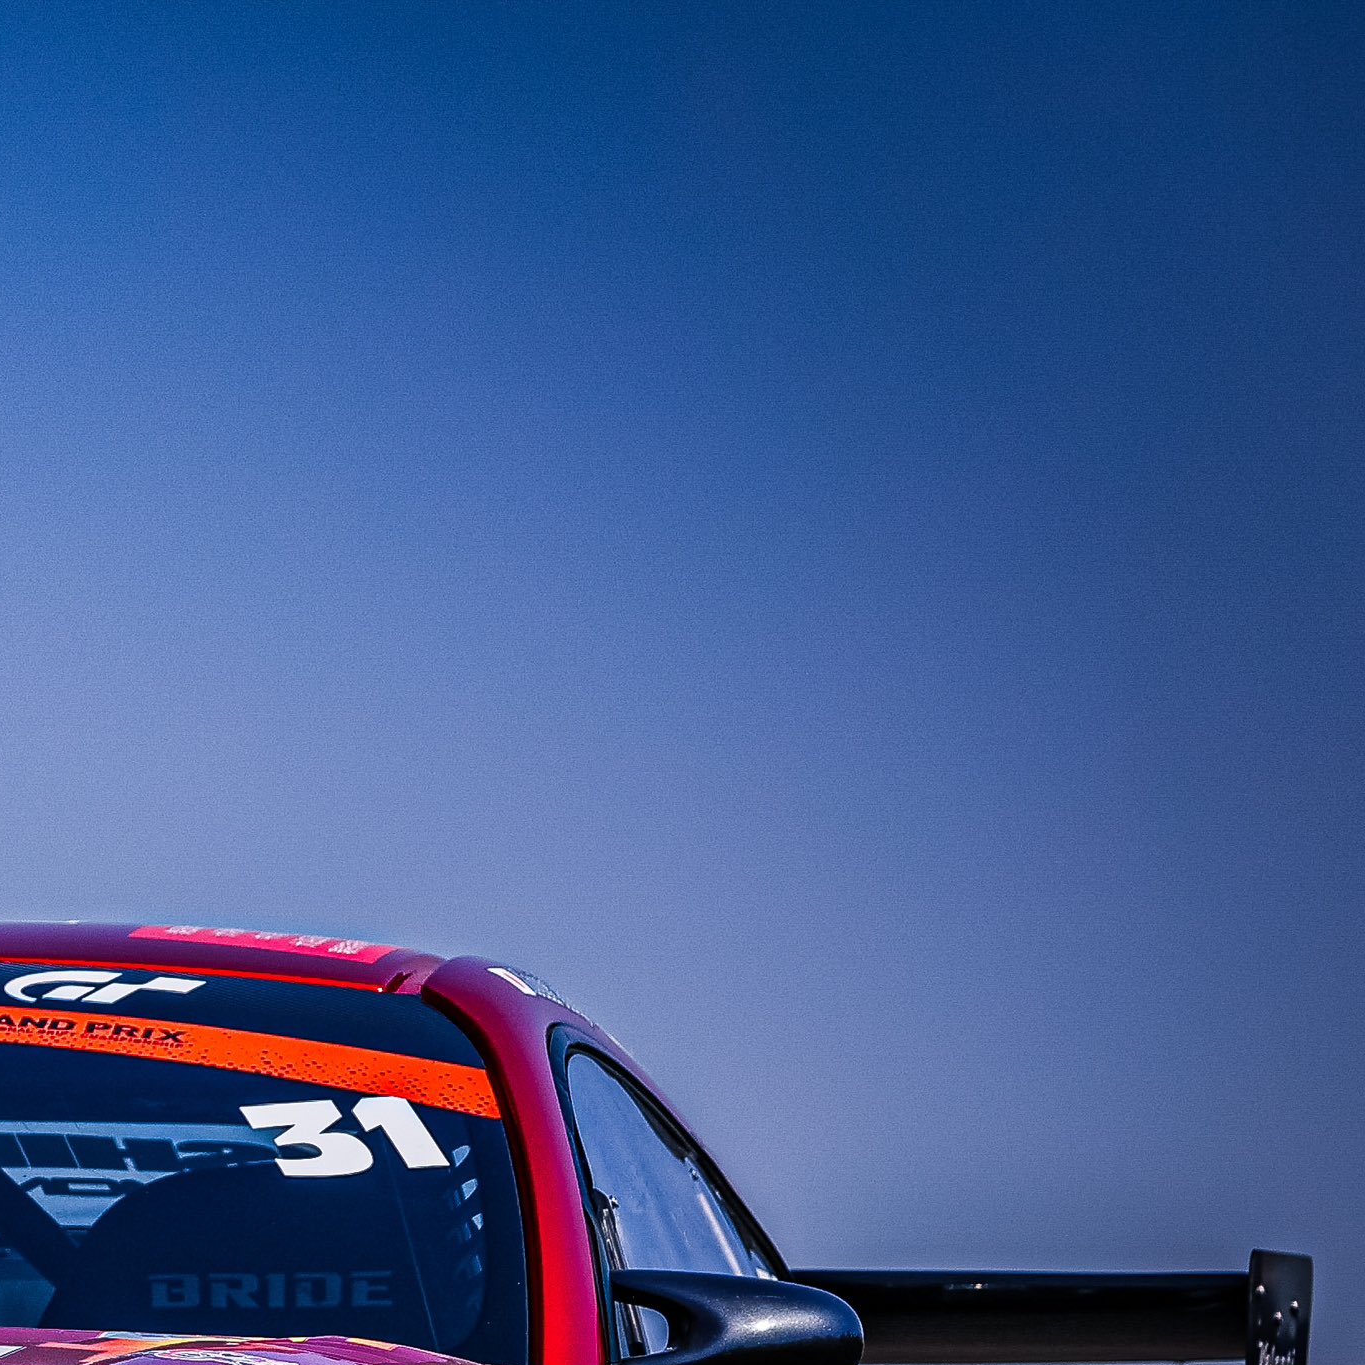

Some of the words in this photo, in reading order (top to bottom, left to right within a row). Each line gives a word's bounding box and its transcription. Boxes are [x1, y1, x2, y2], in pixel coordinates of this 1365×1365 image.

[82, 1021, 191, 1043] PRIX
[238, 1096, 452, 1178] 31
[148, 1269, 393, 1310] BRIDE
